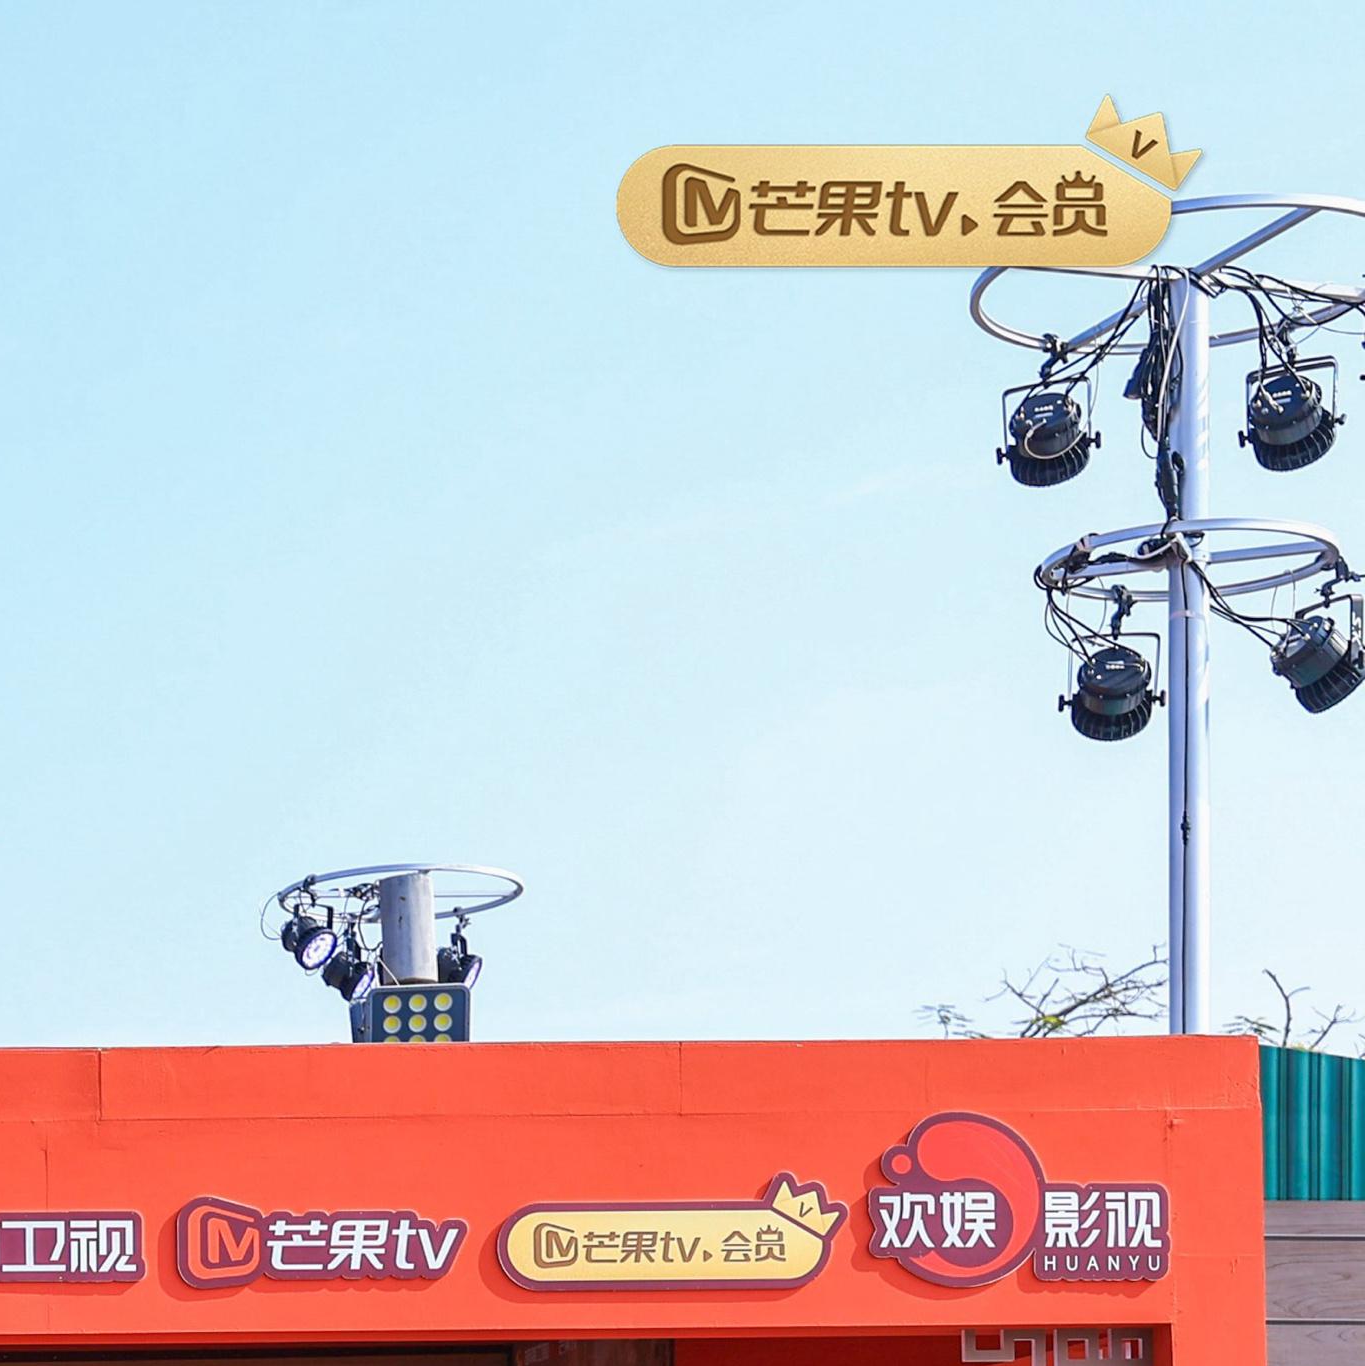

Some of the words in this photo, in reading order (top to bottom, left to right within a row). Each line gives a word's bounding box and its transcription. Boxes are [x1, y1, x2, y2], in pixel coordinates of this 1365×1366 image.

[1044, 1191, 1162, 1250] 影视
[268, 1220, 459, 1271] 芒果tv
[583, 1230, 701, 1263] 芒果tv
[721, 1227, 787, 1263] 会员
[1044, 1255, 1161, 1272] HUANYU
